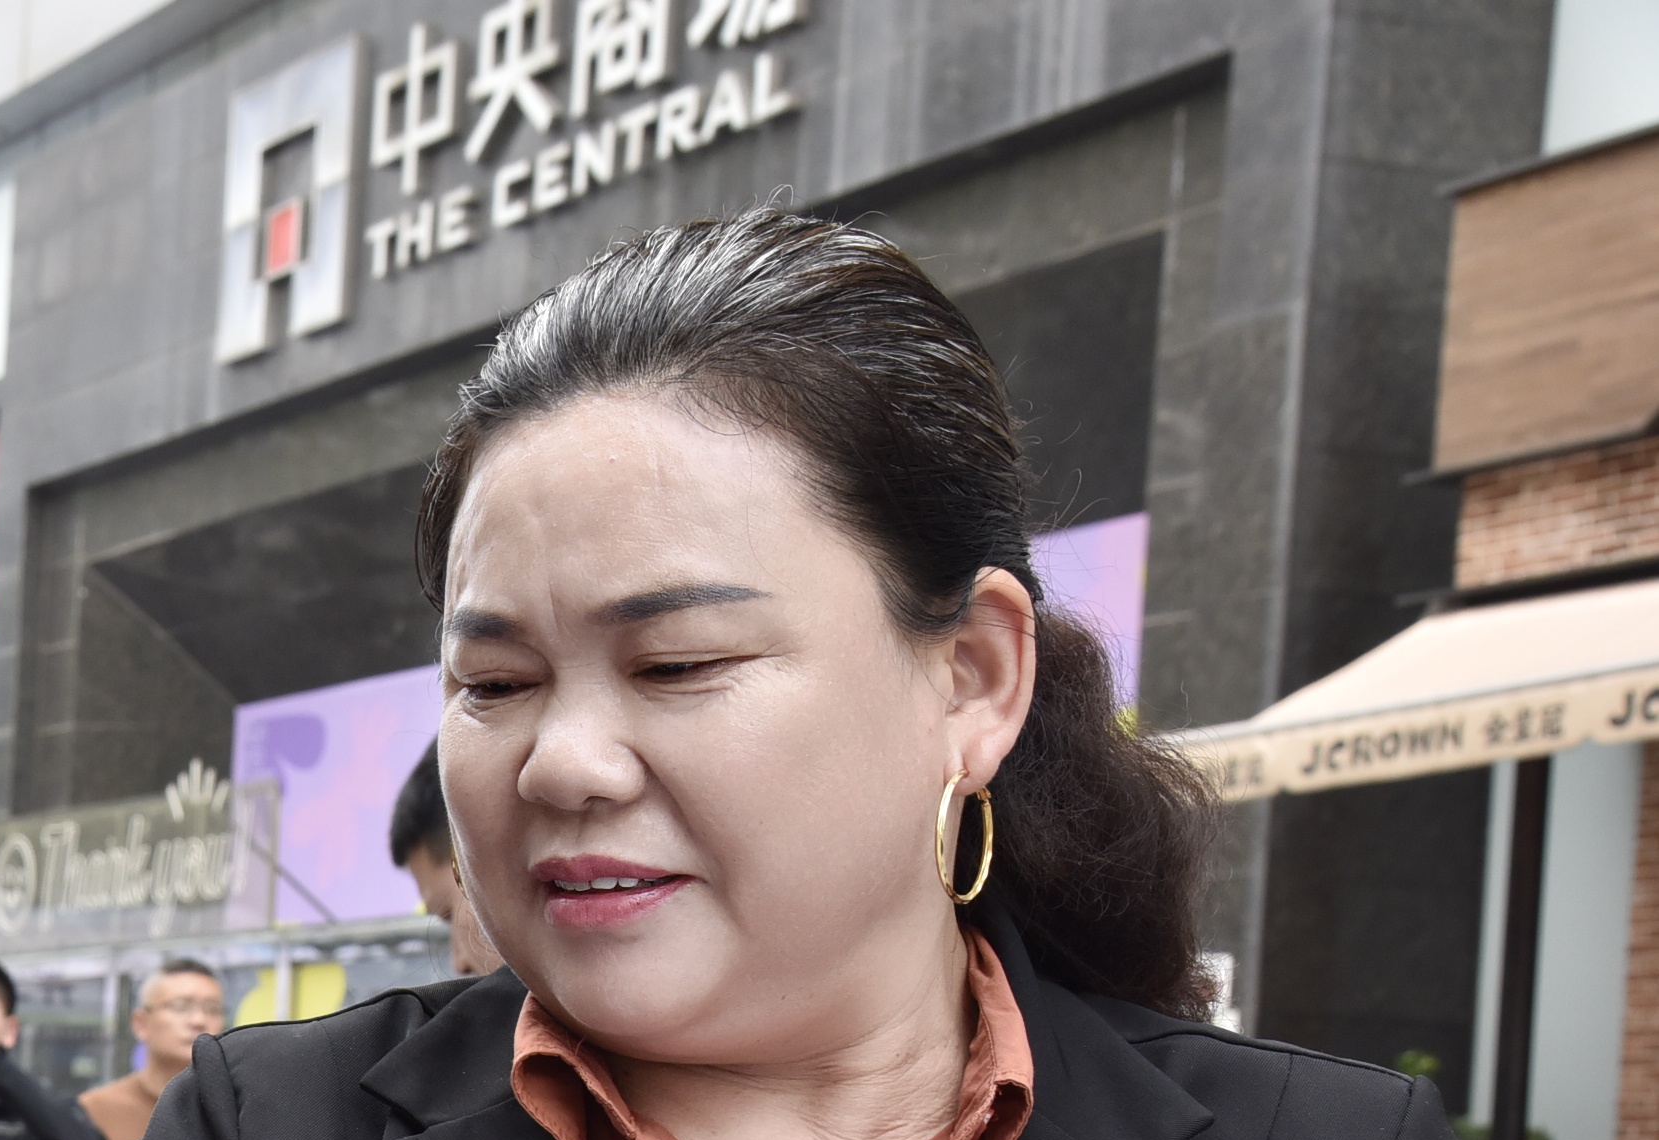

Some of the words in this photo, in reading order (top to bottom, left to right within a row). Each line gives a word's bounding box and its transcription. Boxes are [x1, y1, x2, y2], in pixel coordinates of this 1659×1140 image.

[365, 186, 476, 280] THE
[491, 51, 794, 230] CENTRAL
[1301, 714, 1466, 776] JCROWN
